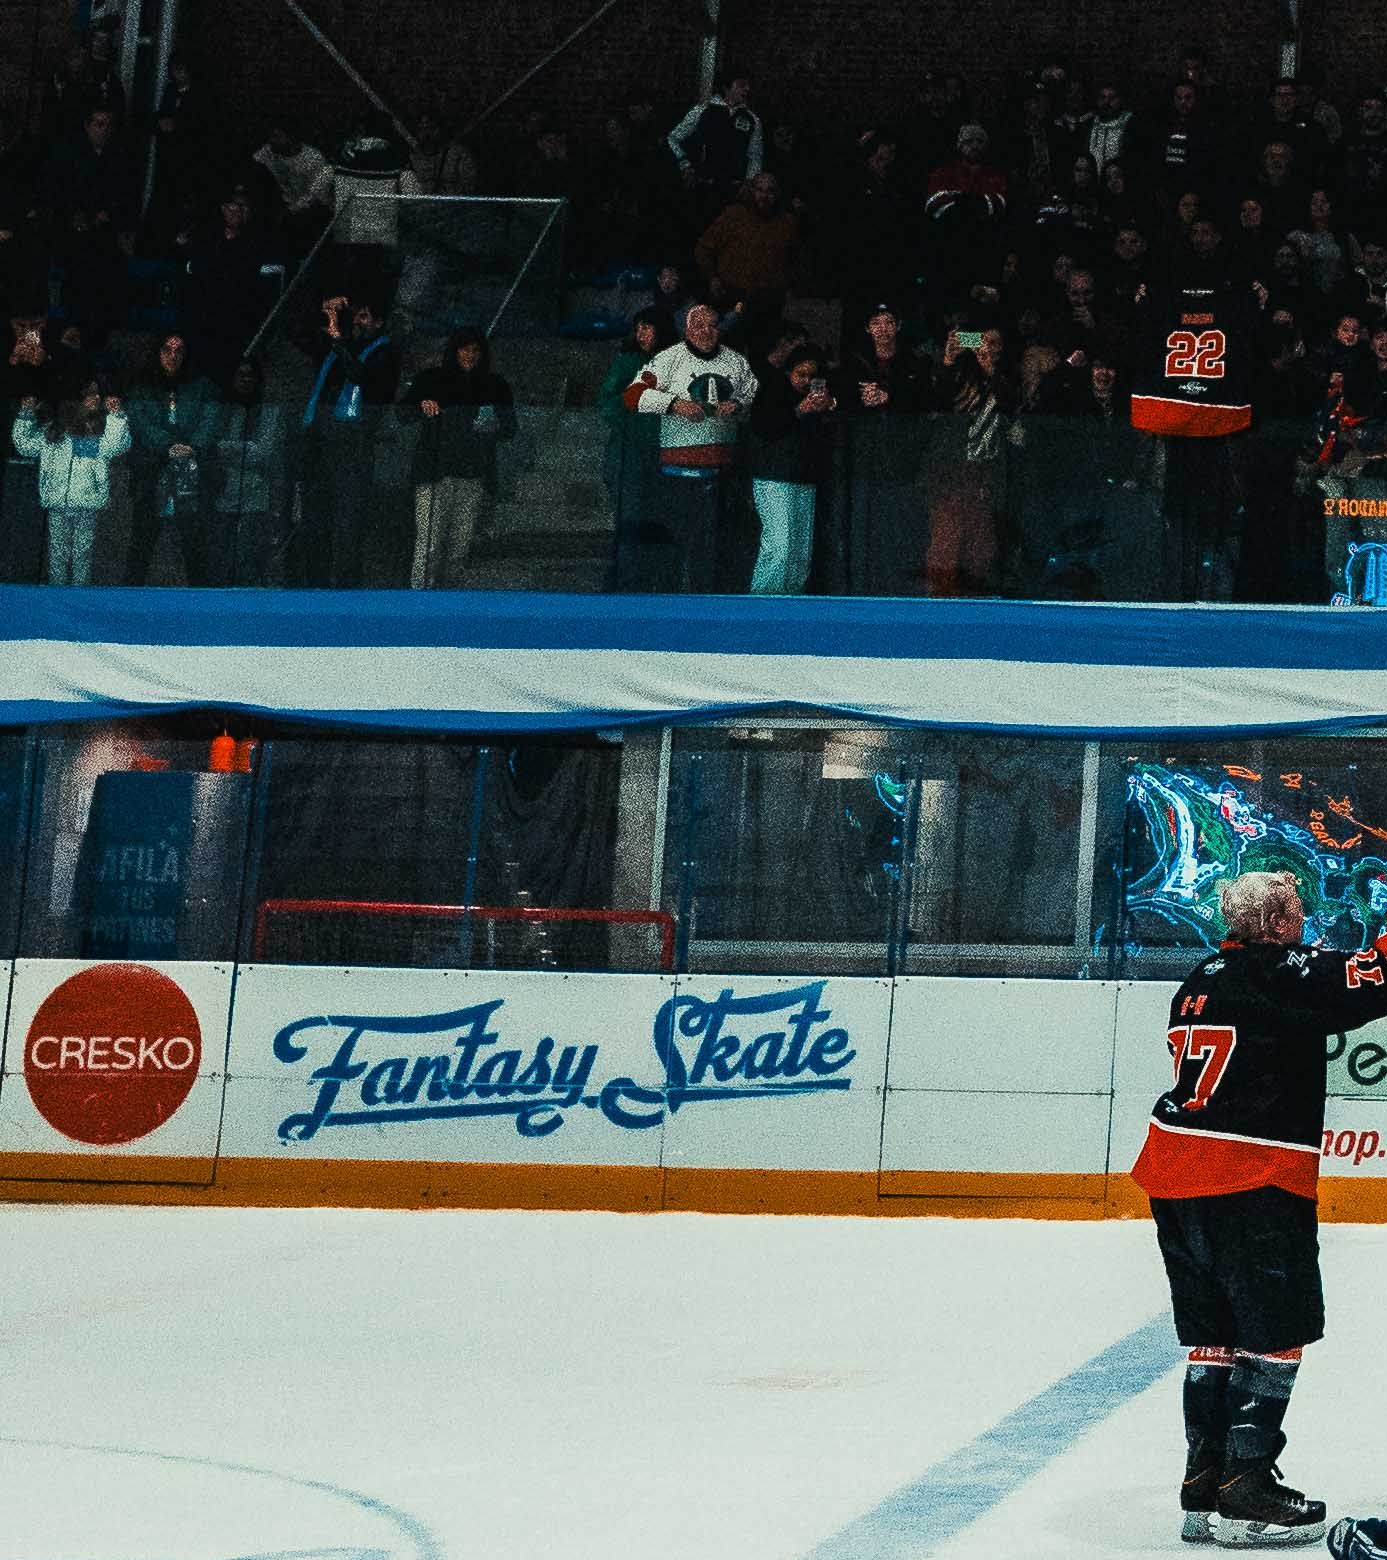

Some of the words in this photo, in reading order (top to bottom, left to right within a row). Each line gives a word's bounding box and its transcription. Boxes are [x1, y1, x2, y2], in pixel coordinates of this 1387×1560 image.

[1164, 329, 1226, 379] 22
[31, 1036, 195, 1070] CRESKO
[273, 998, 600, 1142] Fantasy
[600, 980, 857, 1130] Skate
